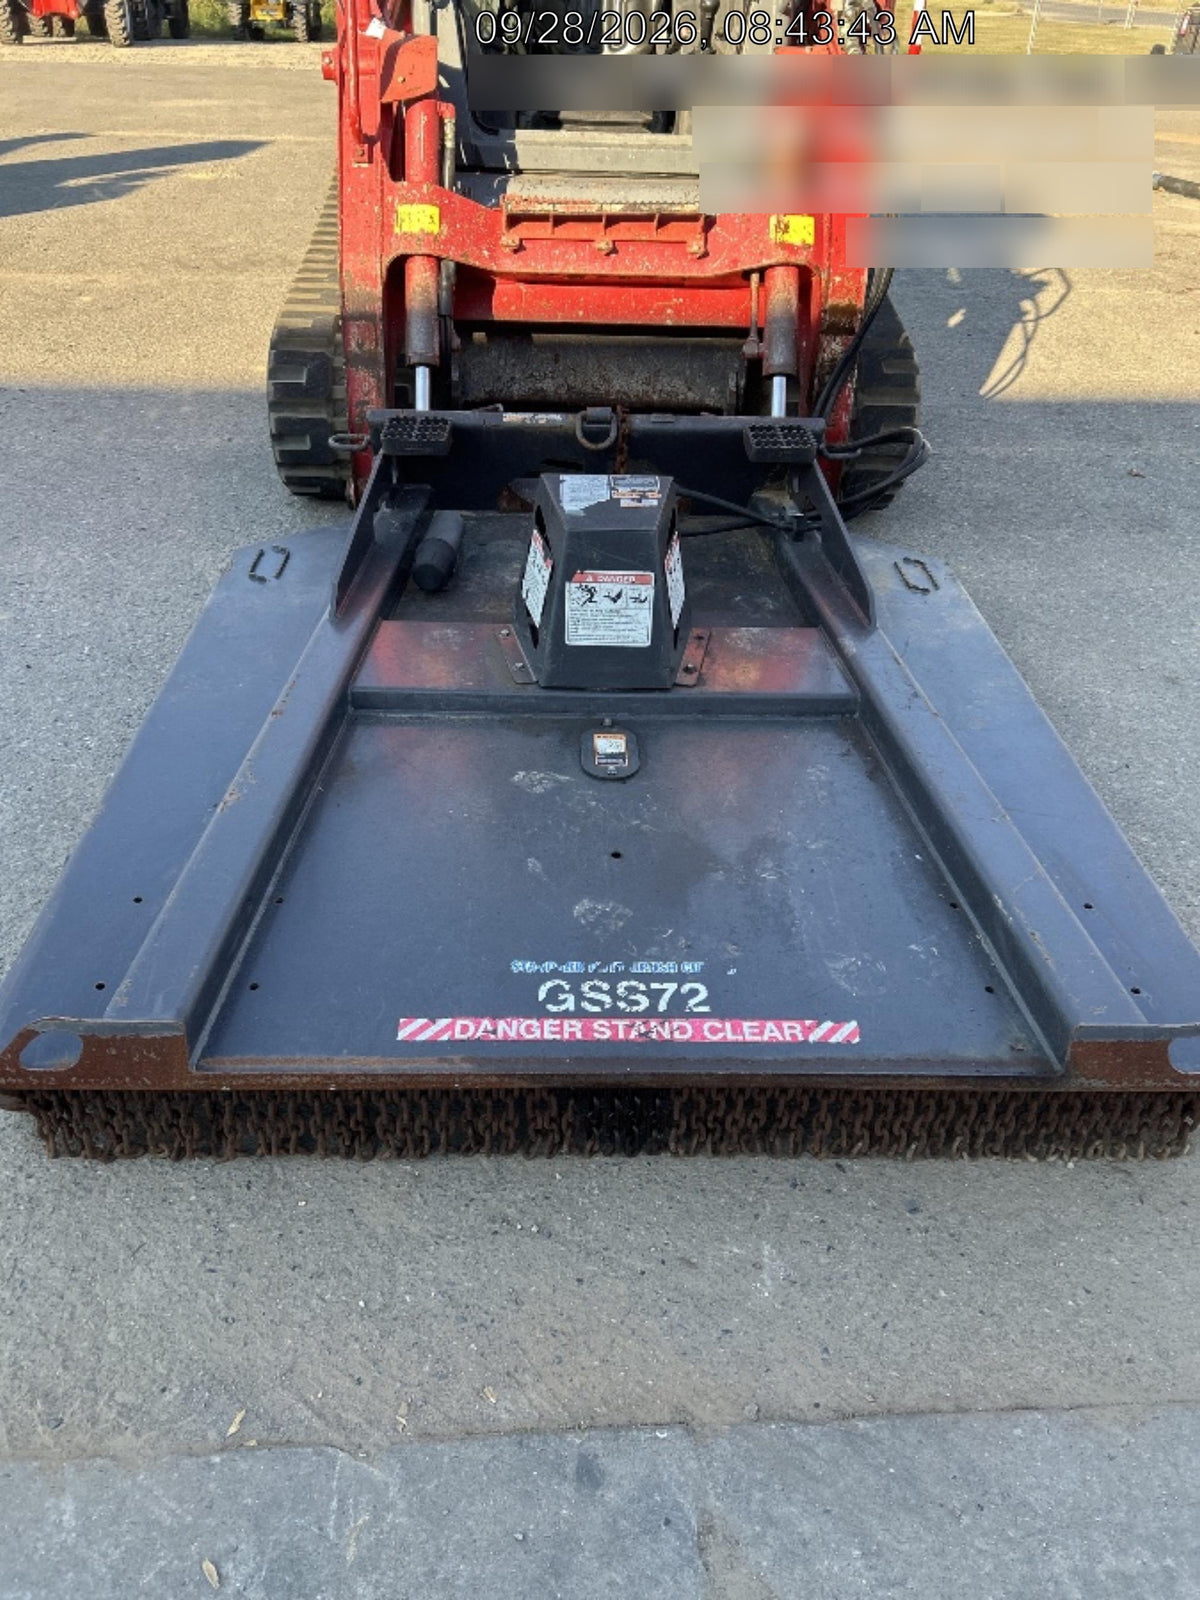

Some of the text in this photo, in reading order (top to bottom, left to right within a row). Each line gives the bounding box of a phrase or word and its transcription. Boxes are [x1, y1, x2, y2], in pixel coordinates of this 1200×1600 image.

[538, 979, 711, 1012] GSS72
[453, 1018, 804, 1041] DANGER STAND CLEAR
